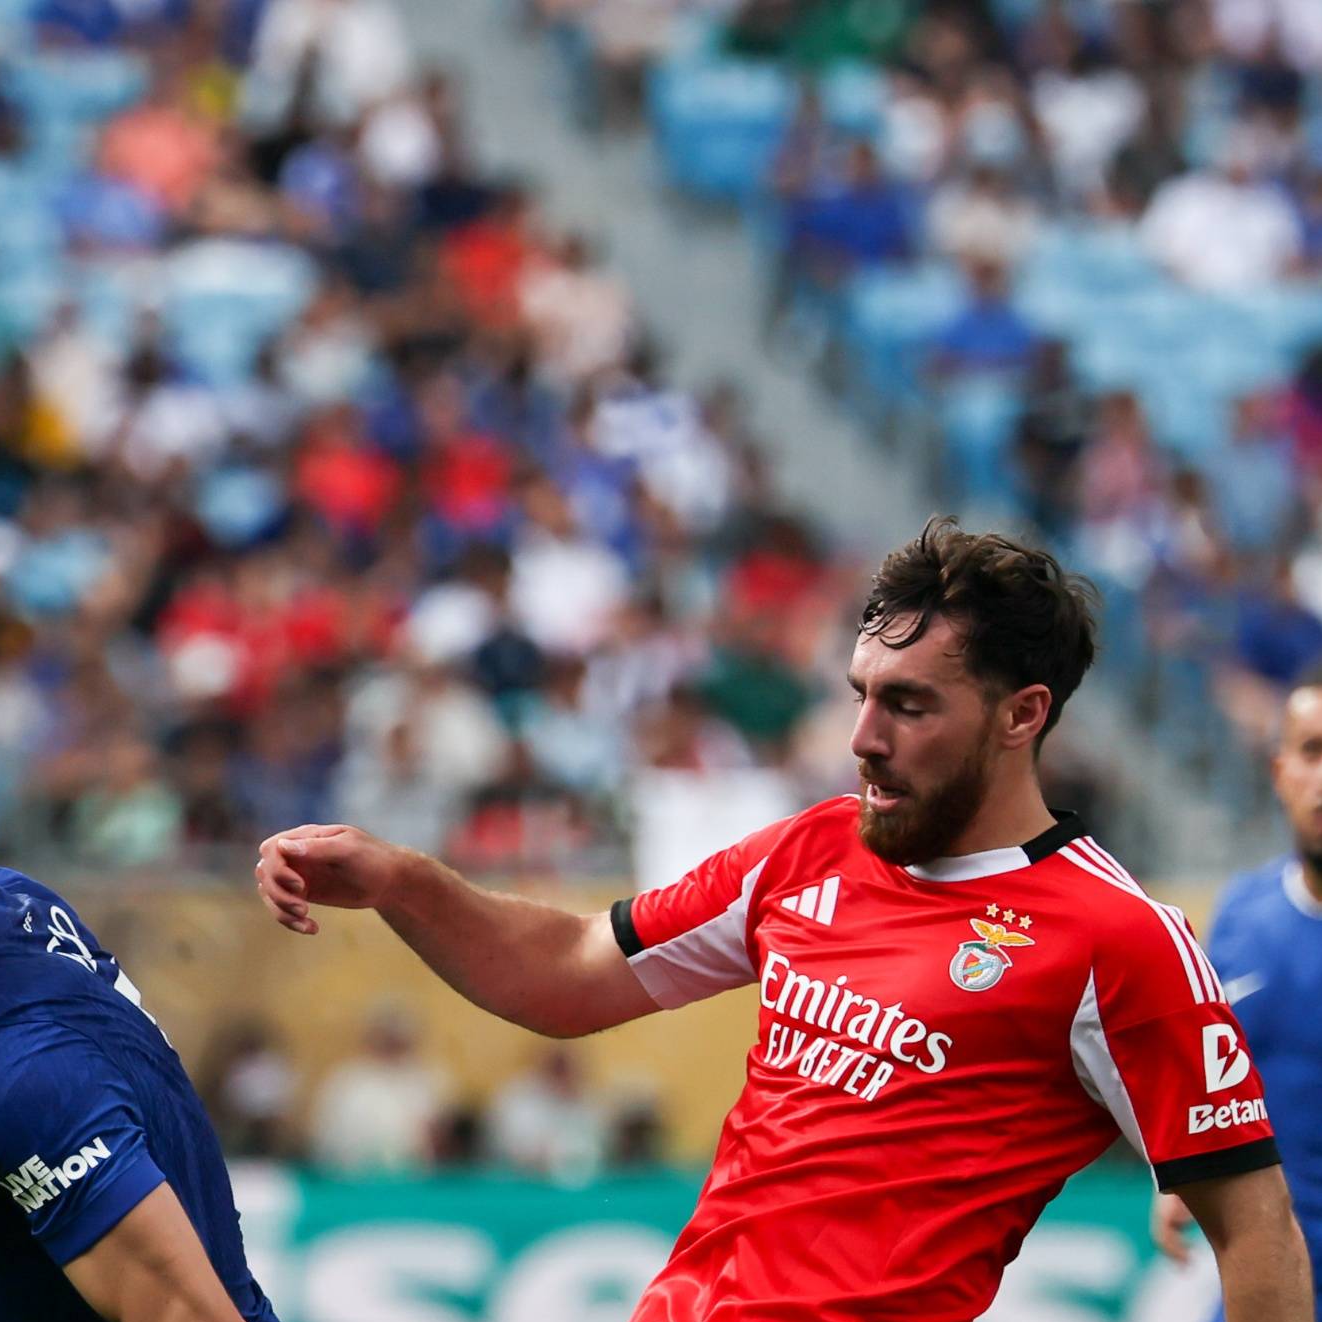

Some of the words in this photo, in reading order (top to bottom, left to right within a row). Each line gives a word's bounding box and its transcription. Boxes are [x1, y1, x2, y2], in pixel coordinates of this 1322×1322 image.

[760, 951, 953, 1074] Emirates
[764, 1022, 806, 1069] FLY
[798, 1037, 894, 1102] BETTER
[1188, 1098, 1268, 1134] Betan
[13, 1137, 112, 1214] NATION
